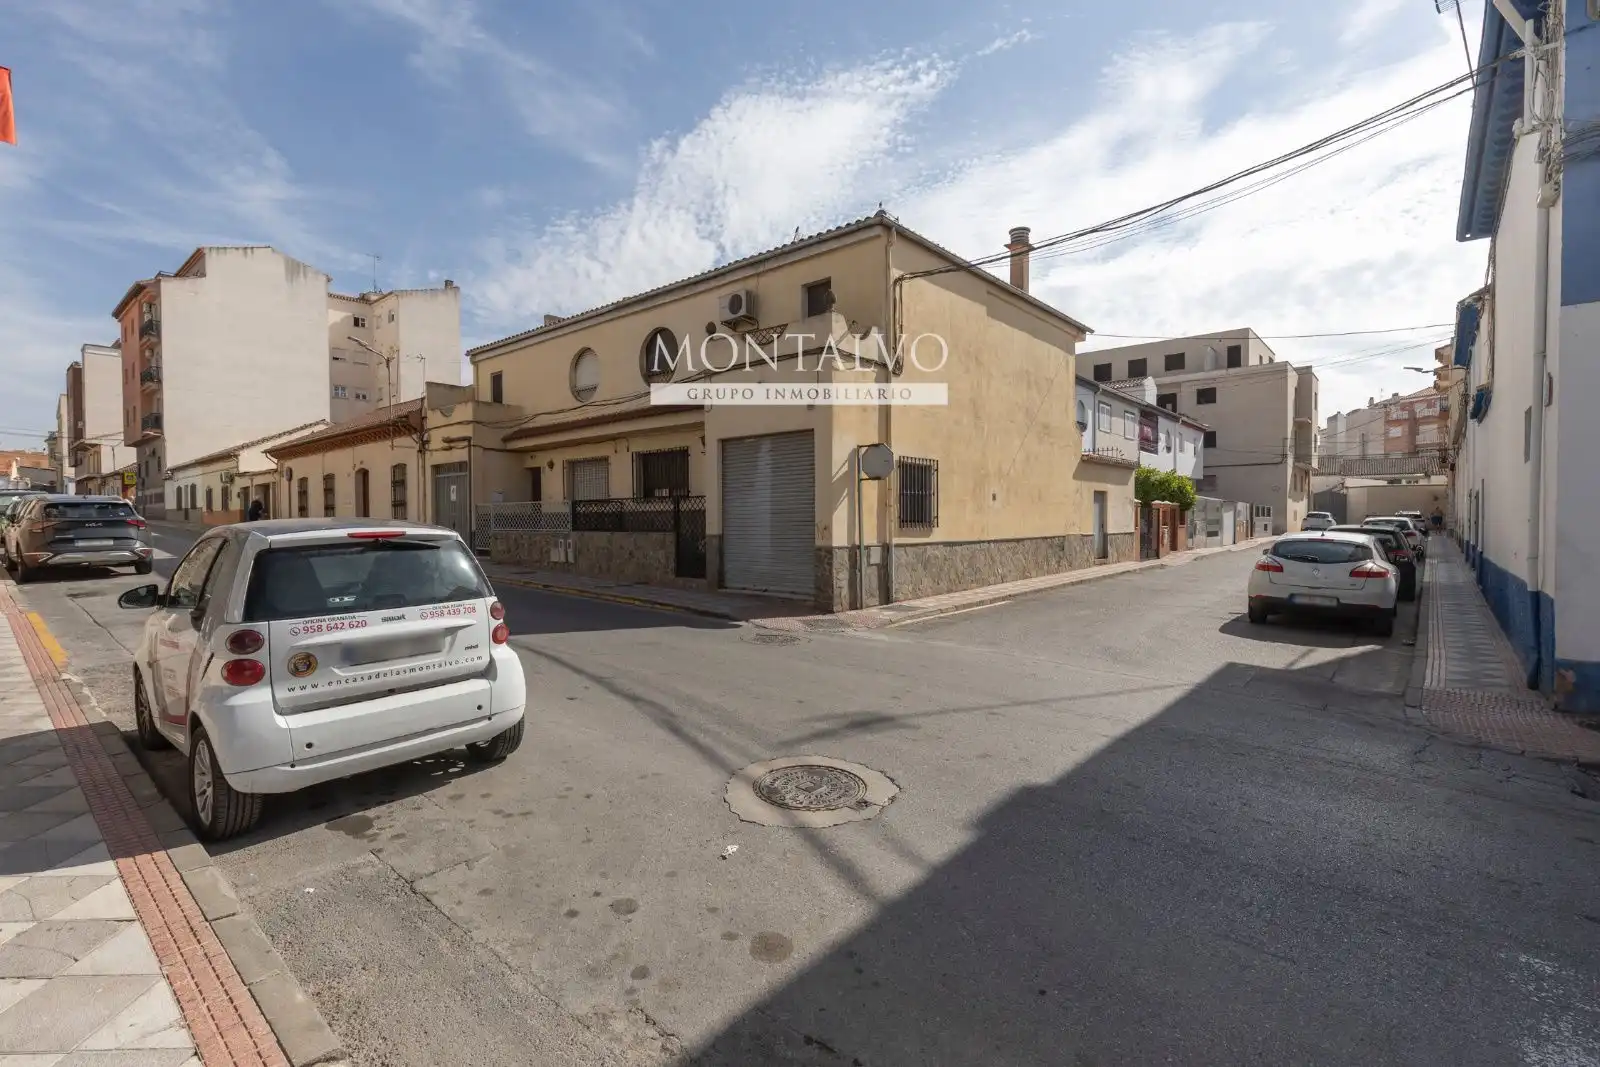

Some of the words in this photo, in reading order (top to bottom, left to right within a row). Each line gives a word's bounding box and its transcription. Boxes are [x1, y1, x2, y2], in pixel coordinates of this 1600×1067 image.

[430, 609, 445, 618] 958
[446, 608, 461, 616] 439
[463, 606, 477, 615] 708
[302, 617, 327, 625] OFICINA
[302, 624, 323, 634] 958
[326, 622, 346, 632] 642
[348, 619, 367, 629] 620
